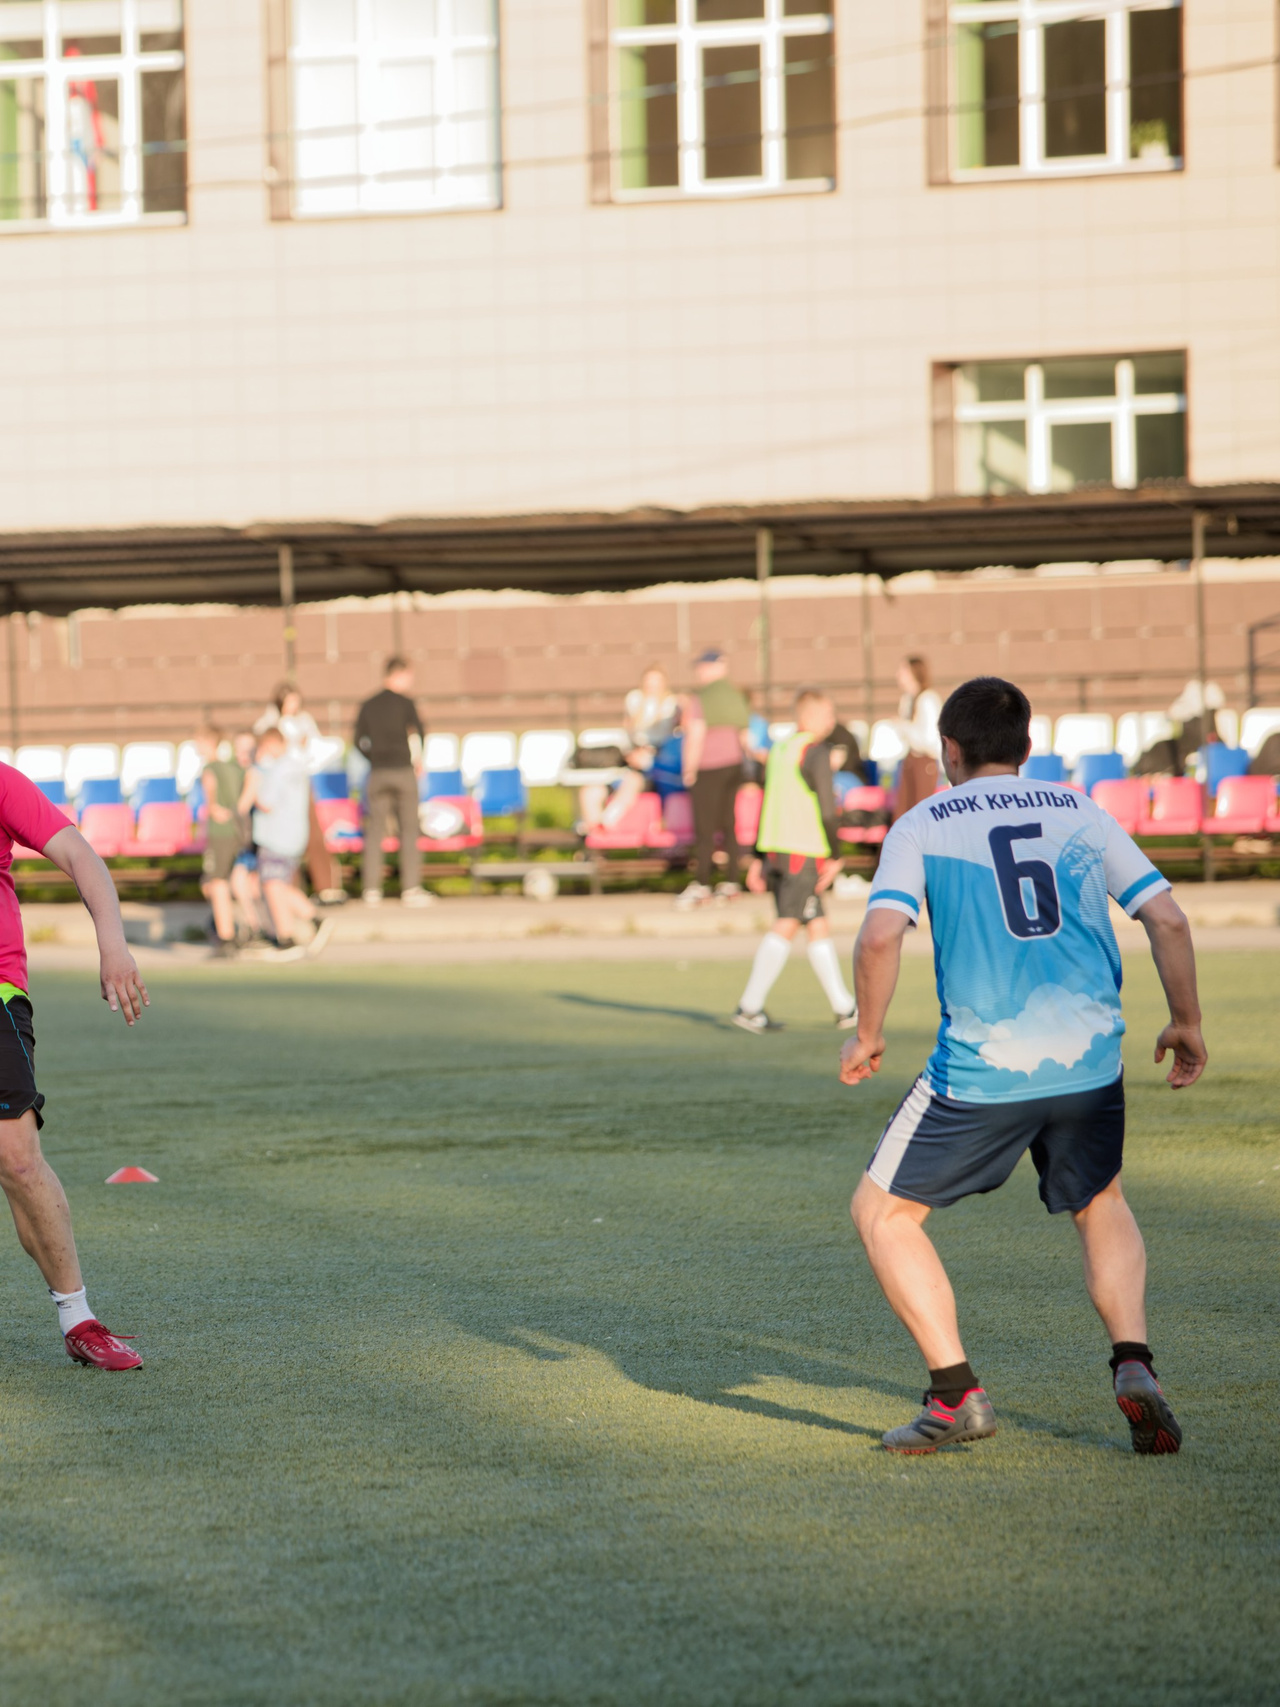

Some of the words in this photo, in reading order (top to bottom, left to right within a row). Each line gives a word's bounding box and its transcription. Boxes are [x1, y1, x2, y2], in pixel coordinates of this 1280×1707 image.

[929, 794, 984, 821] МФК
[984, 790, 1079, 812] КРЫЛЬЯ
[988, 822, 1061, 940] 6
